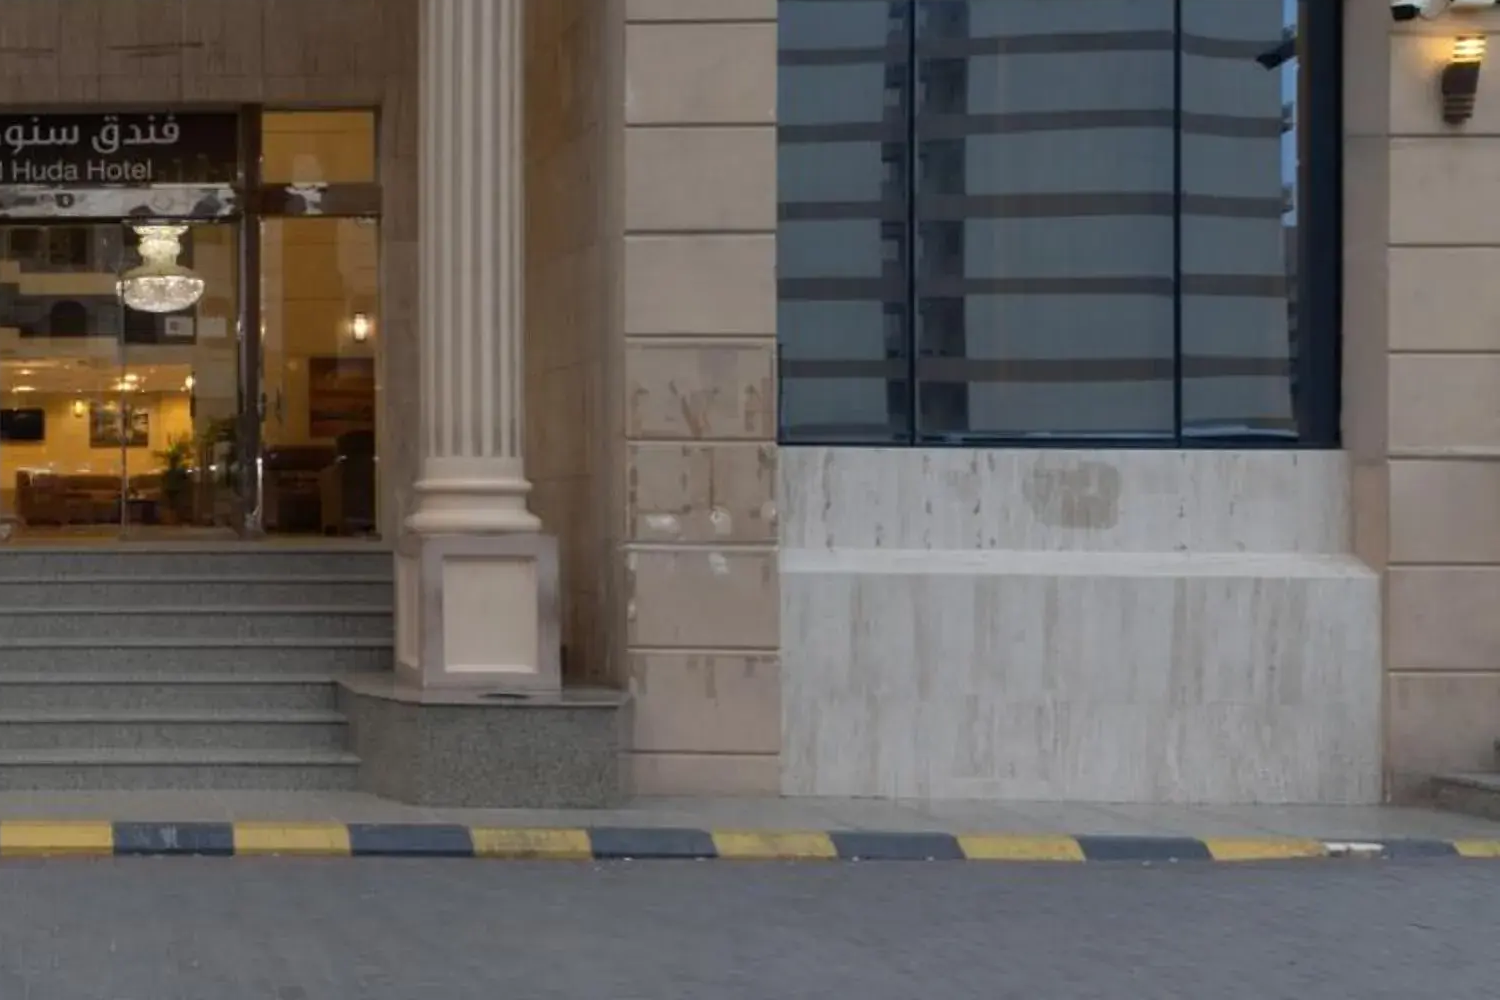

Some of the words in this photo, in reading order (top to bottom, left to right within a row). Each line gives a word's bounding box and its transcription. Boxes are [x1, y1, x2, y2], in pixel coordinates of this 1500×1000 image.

[92, 115, 180, 154] فندق
[12, 160, 79, 181] Huda
[86, 159, 153, 181] Hotel
